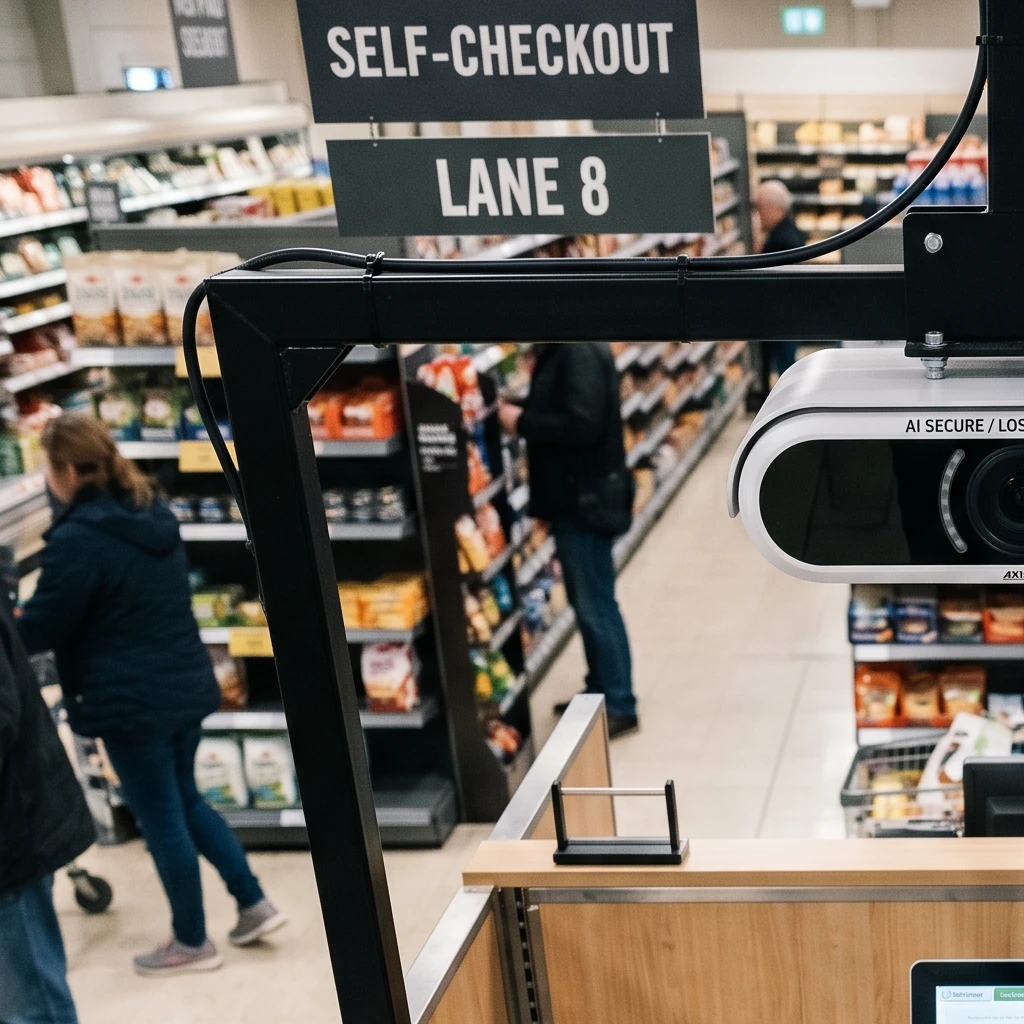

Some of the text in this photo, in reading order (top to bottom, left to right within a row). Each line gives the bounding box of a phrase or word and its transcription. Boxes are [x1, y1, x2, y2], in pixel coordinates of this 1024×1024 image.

[326, 22, 674, 79] SELF-CHECKOUT
[435, 156, 610, 217] LANE 8
[905, 419, 920, 433] AI
[925, 418, 985, 433] SECURE
